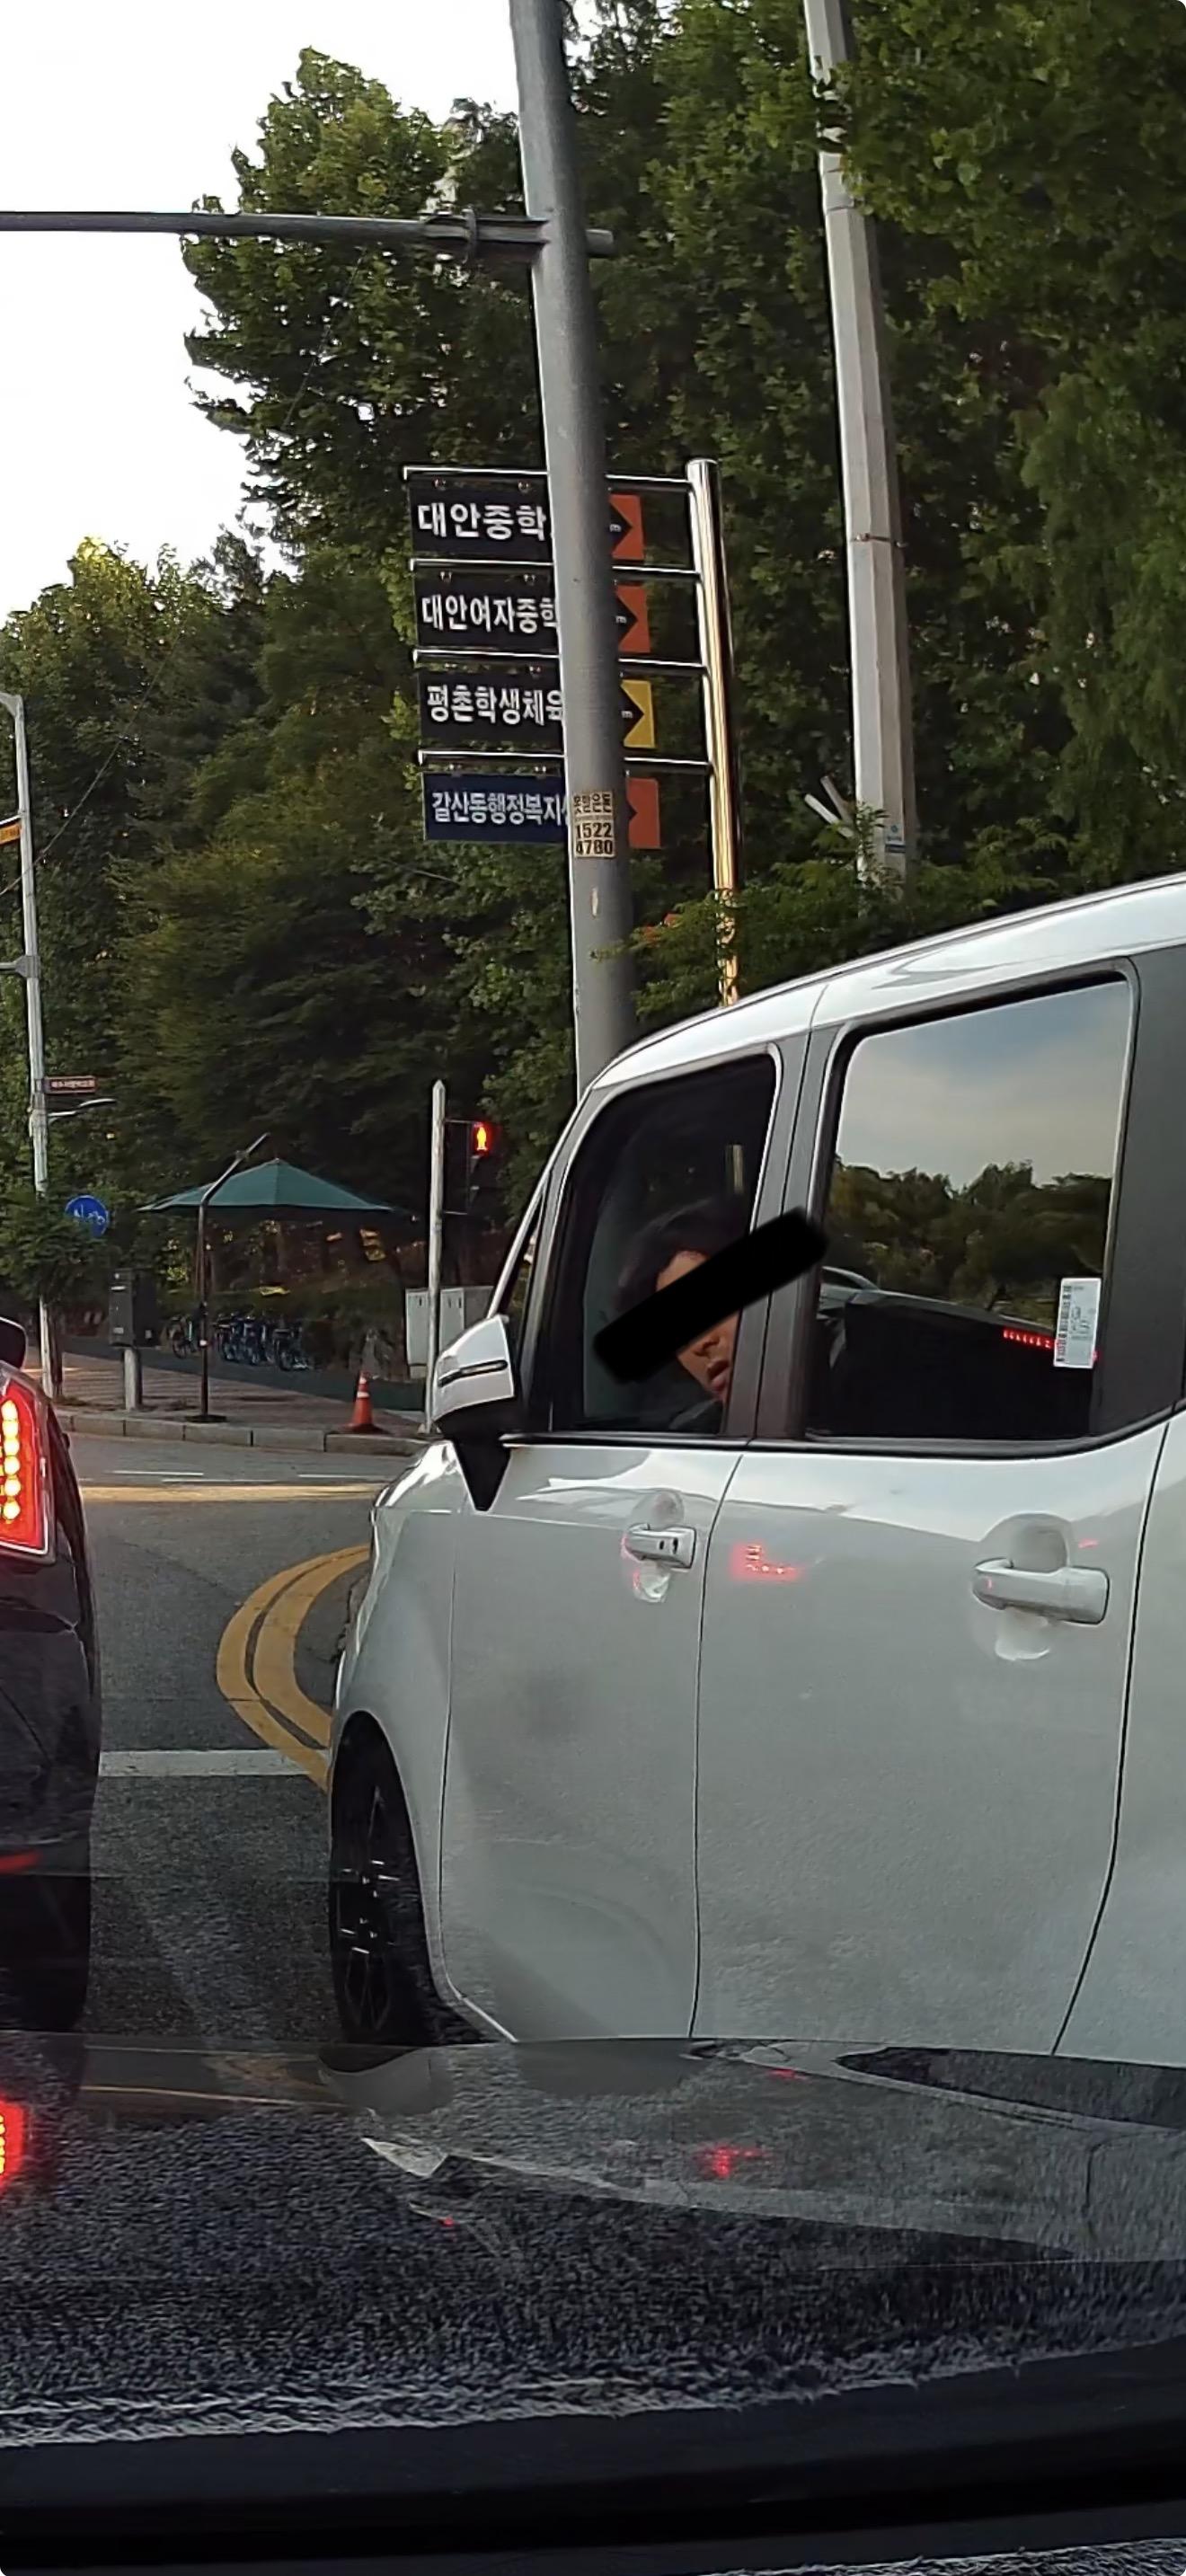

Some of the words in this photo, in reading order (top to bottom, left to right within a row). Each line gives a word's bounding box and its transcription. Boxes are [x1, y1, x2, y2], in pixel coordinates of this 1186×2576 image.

[417, 502, 552, 541] 대안중학
[576, 822, 613, 838] 1522
[576, 839, 613, 855] 4780
